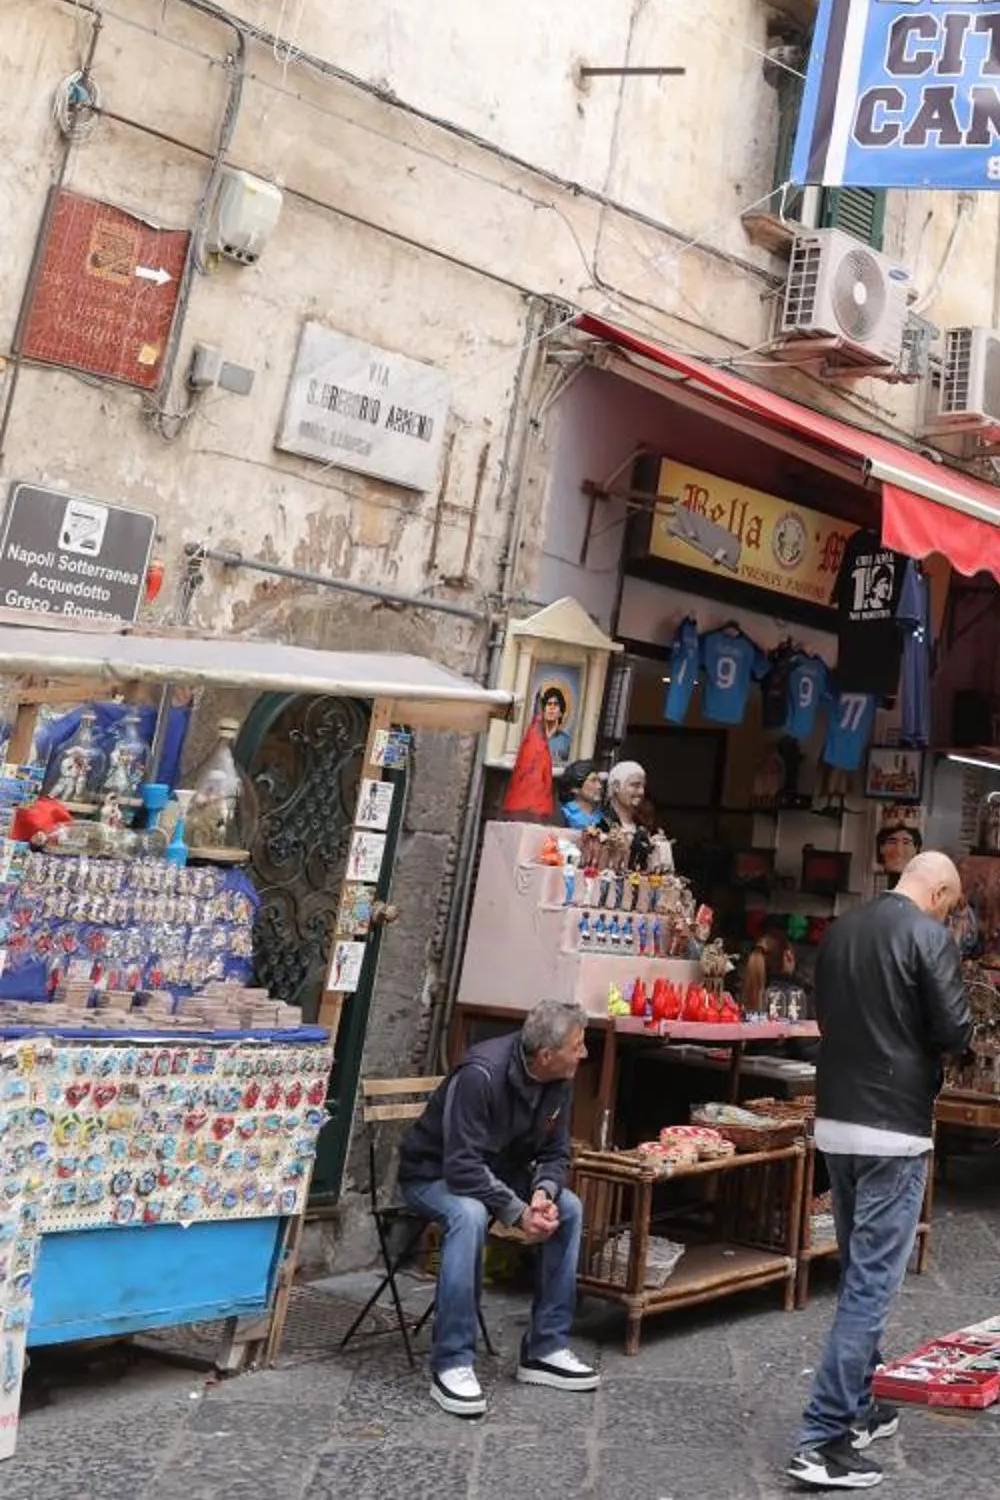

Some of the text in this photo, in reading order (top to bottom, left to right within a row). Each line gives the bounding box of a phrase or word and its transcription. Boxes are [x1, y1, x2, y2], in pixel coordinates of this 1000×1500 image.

[368, 361, 391, 388] VIA
[384, 404, 435, 443] ARMENO
[682, 483, 765, 549] Bella
[7, 542, 140, 585] Napoli Sotterranea
[5, 589, 51, 612] Greco
[26, 571, 111, 601] Acquedotto
[716, 657, 738, 689] 9
[800, 676, 815, 708] 9
[838, 692, 868, 733] 77
